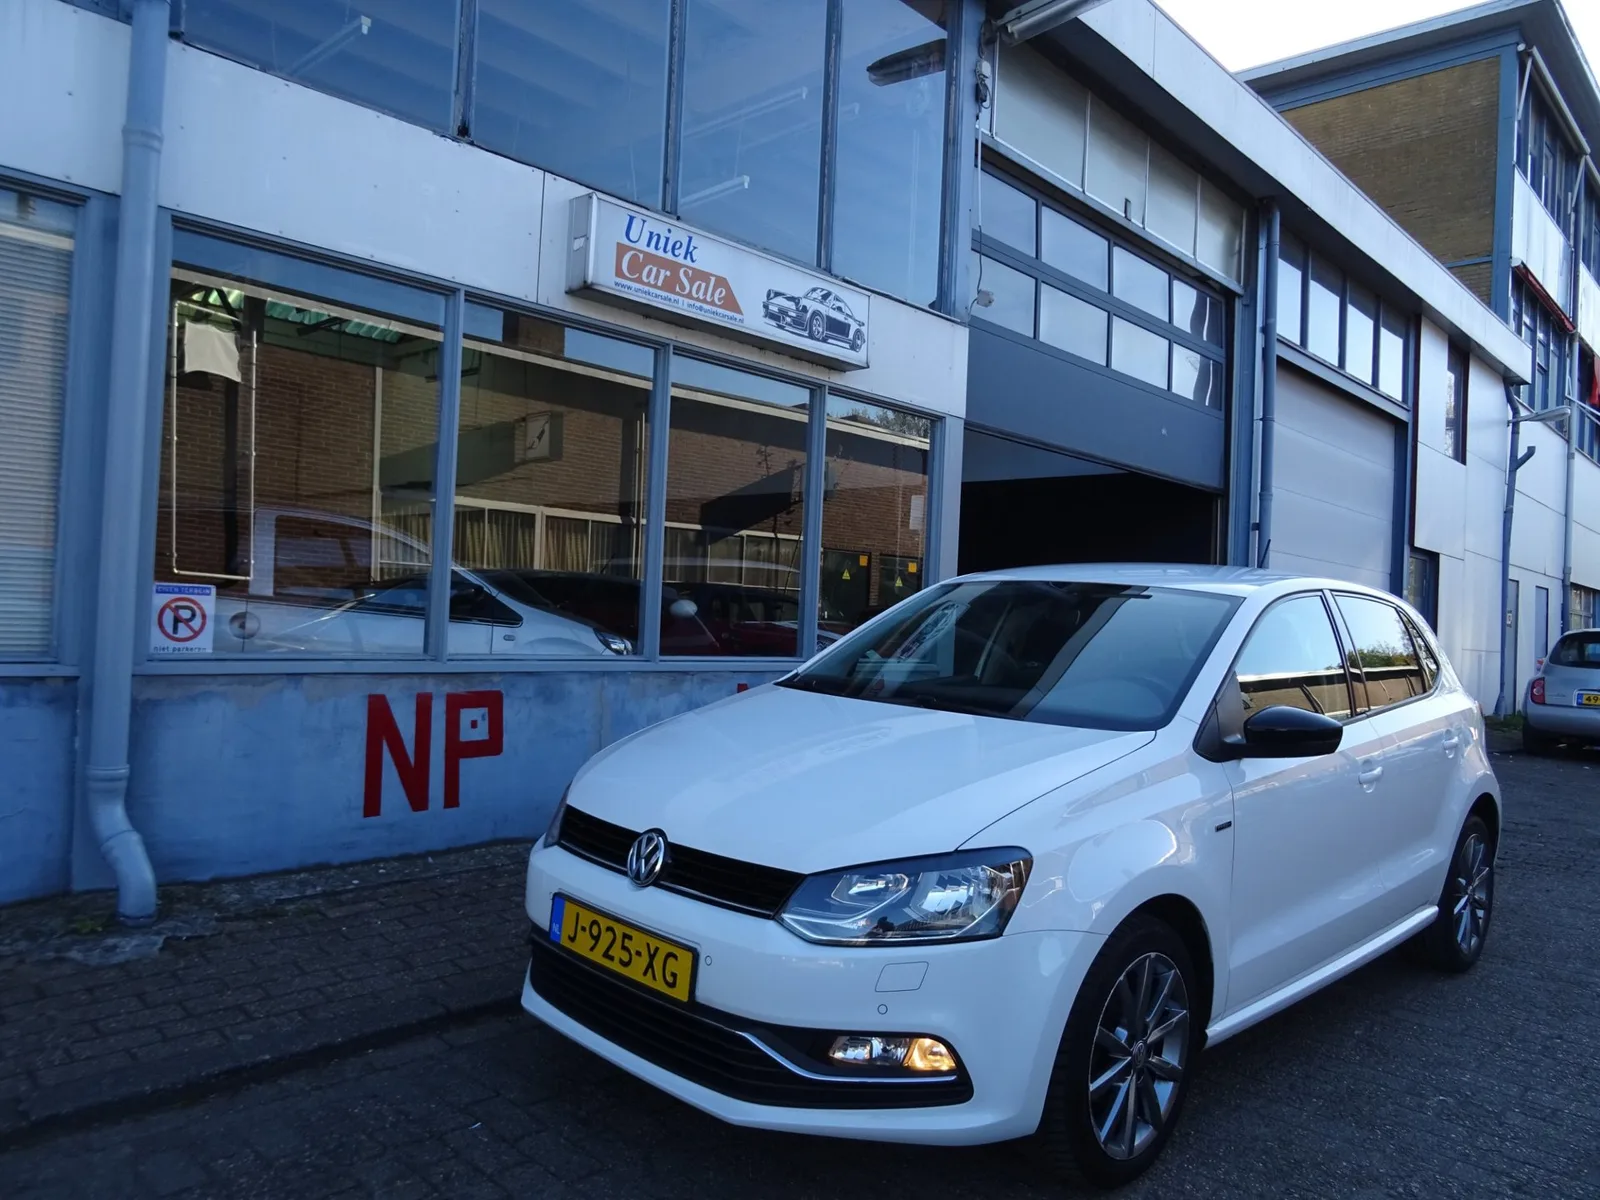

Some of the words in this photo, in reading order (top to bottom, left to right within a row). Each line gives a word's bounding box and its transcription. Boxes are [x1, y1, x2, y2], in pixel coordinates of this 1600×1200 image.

[625, 214, 698, 263] Uniek
[614, 280, 680, 305] www.uniekcarsale.nl
[686, 303, 745, 324] info@uniekcarsale.nl
[621, 250, 671, 288] Car
[676, 267, 726, 305] Sale
[153, 645, 169, 653] niet
[362, 689, 504, 818] NP
[567, 911, 679, 989] J-925-XG
